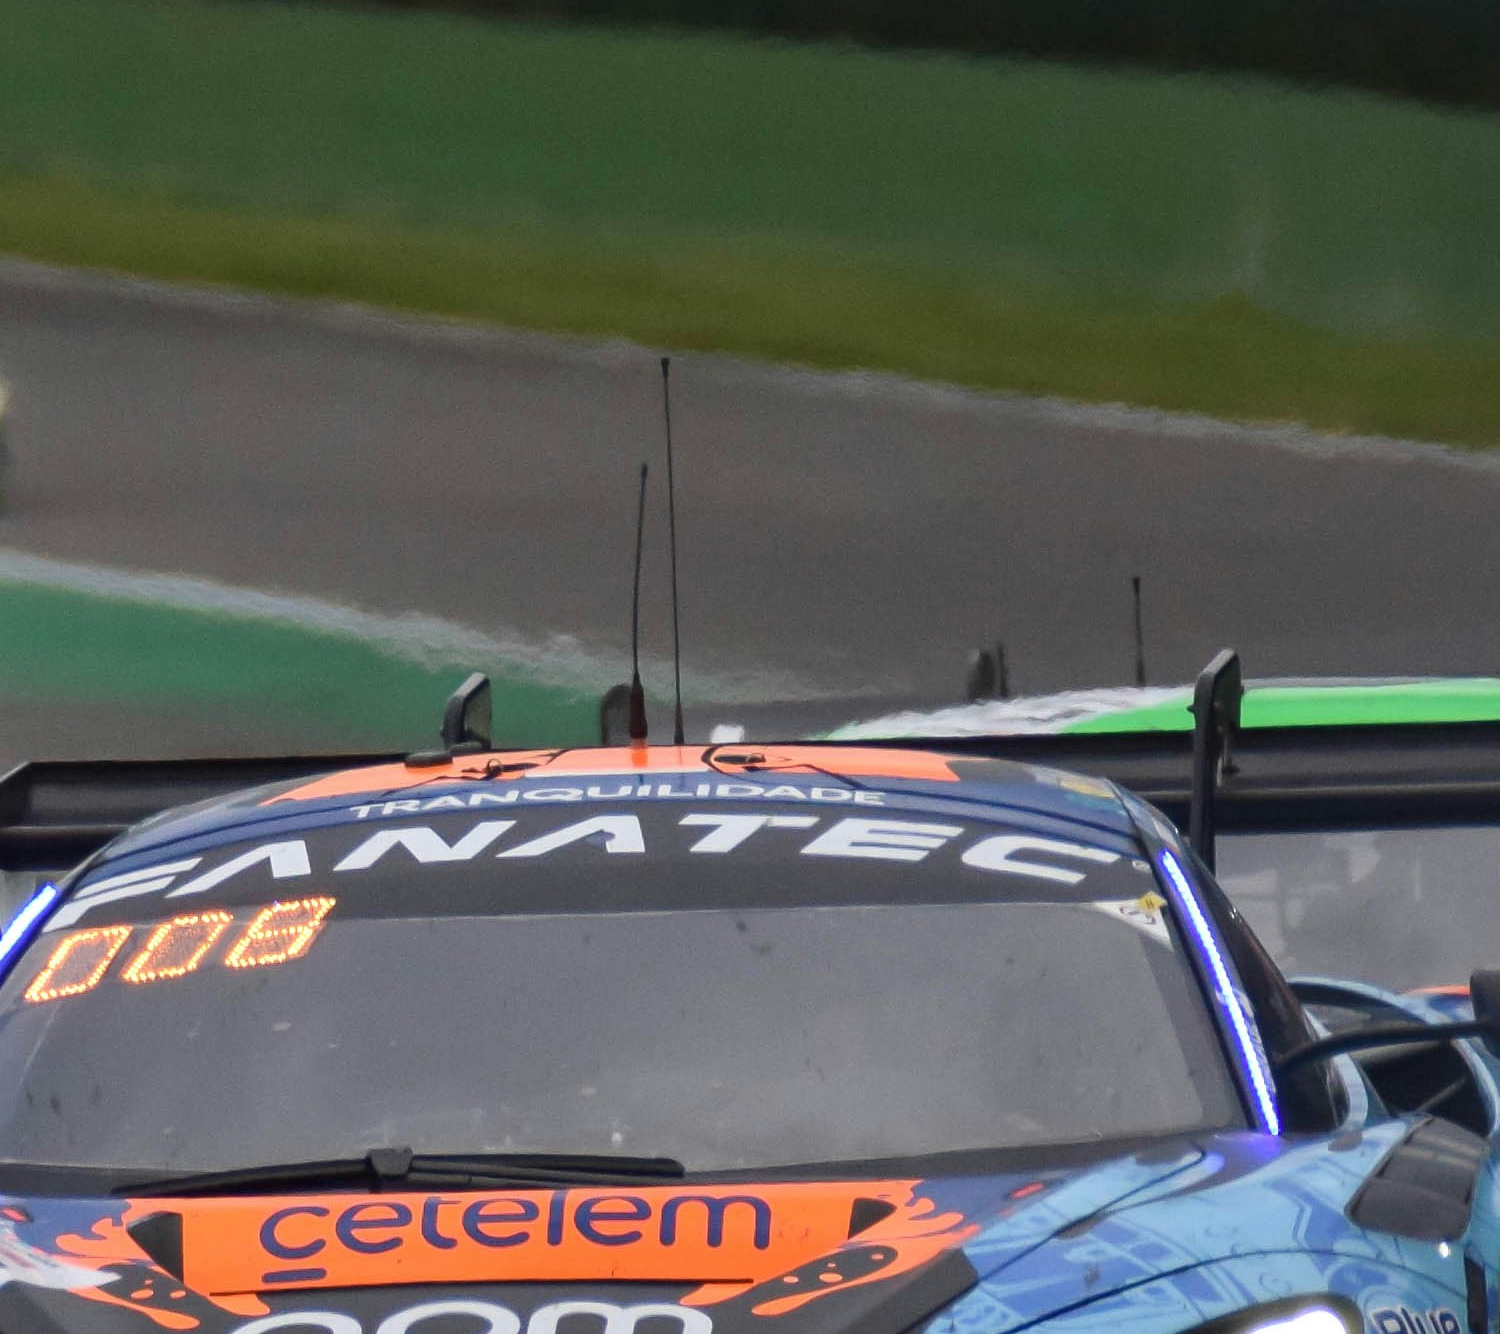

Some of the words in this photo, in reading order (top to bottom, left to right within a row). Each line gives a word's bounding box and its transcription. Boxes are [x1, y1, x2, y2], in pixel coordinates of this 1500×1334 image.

[349, 782, 885, 819] TRANQUILIDADE
[42, 813, 1122, 933] FANATEC
[259, 1189, 772, 1259] cetelem
